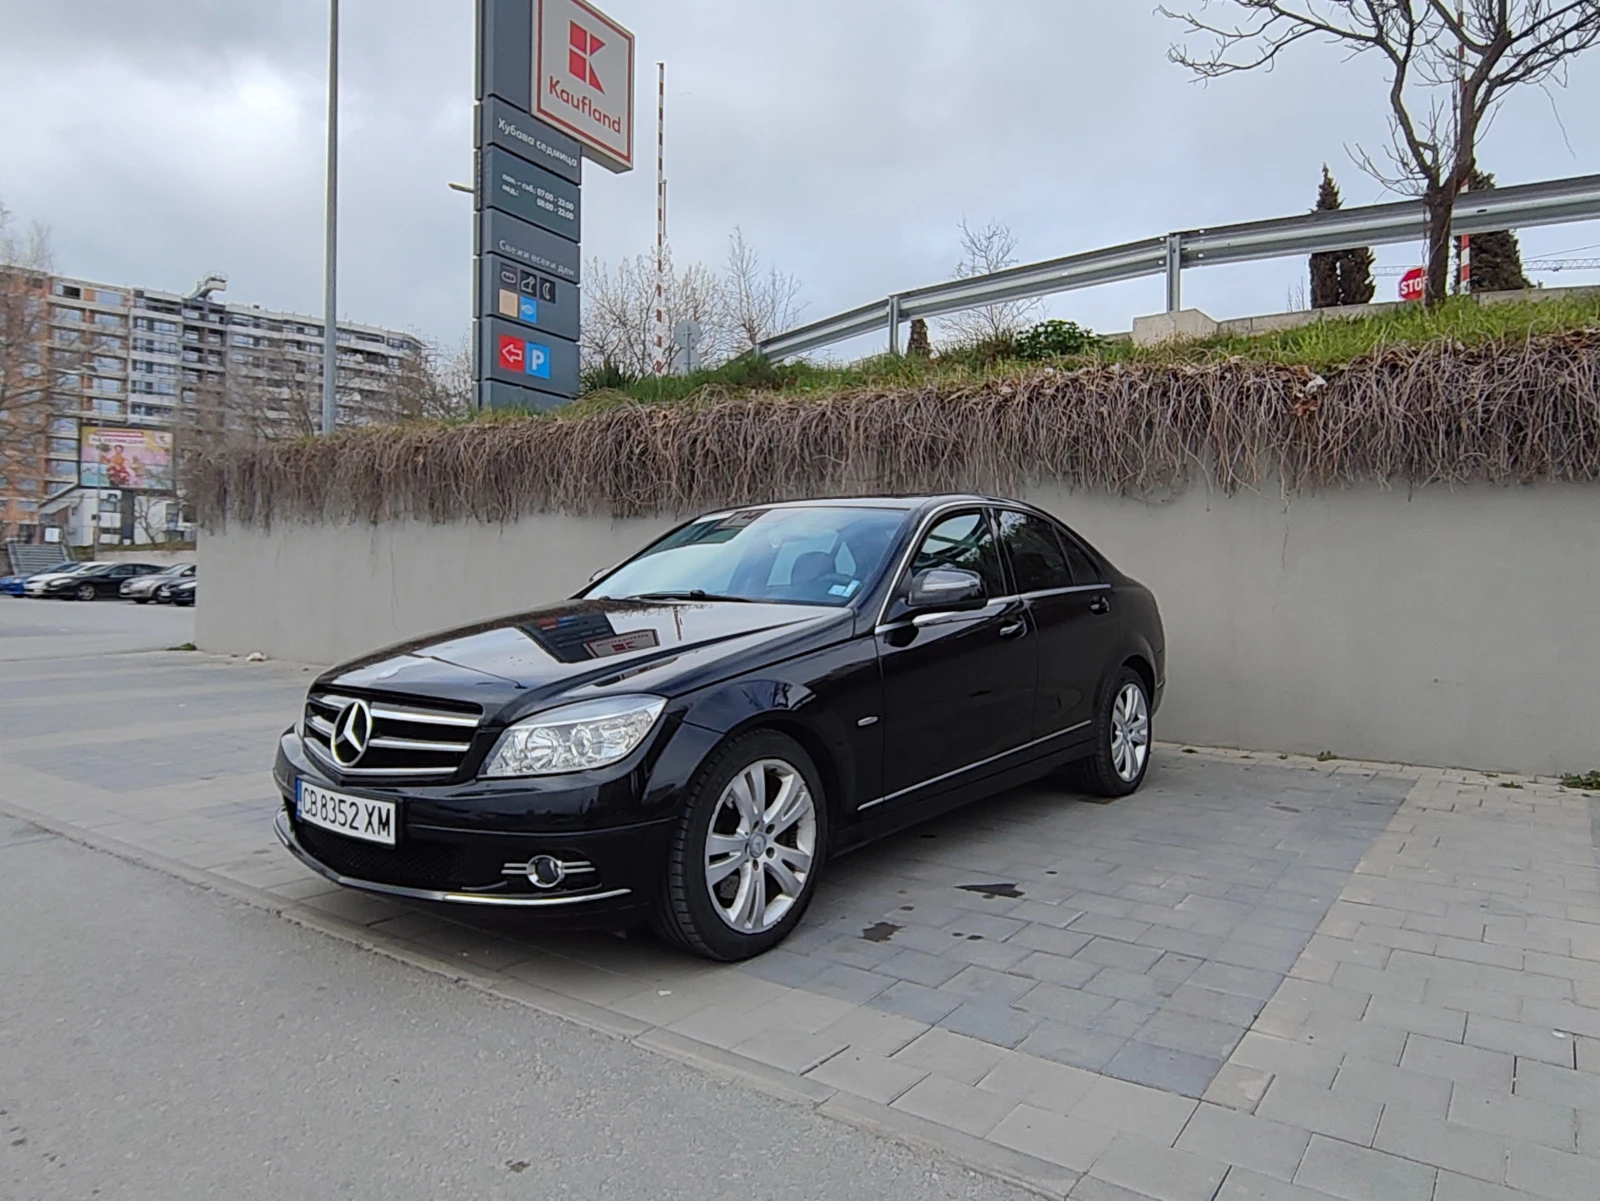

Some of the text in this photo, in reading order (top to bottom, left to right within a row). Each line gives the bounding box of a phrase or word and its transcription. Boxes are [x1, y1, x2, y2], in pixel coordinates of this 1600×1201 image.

[549, 75, 621, 134] Kaufland
[498, 118, 577, 167] Хубава седмица
[531, 349, 545, 371] P
